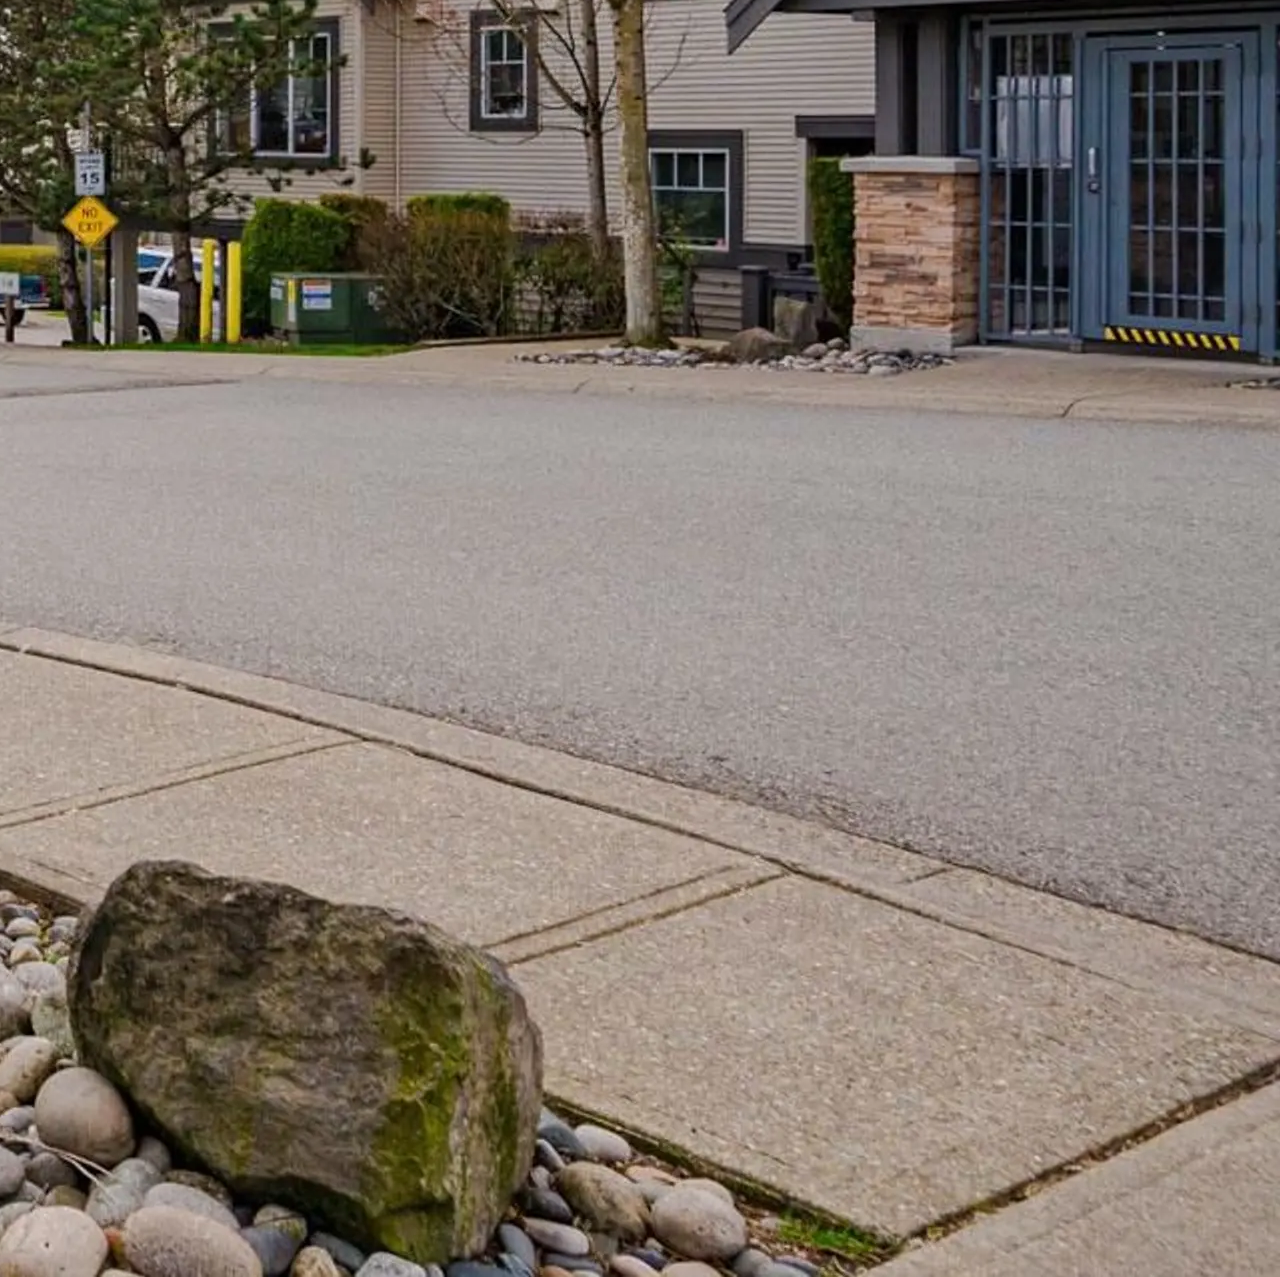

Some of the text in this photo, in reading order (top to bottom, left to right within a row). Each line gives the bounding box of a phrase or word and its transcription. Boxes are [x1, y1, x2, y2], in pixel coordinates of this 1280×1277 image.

[80, 172, 100, 185] 15
[81, 207, 98, 219] NO
[78, 222, 102, 234] EXIT
